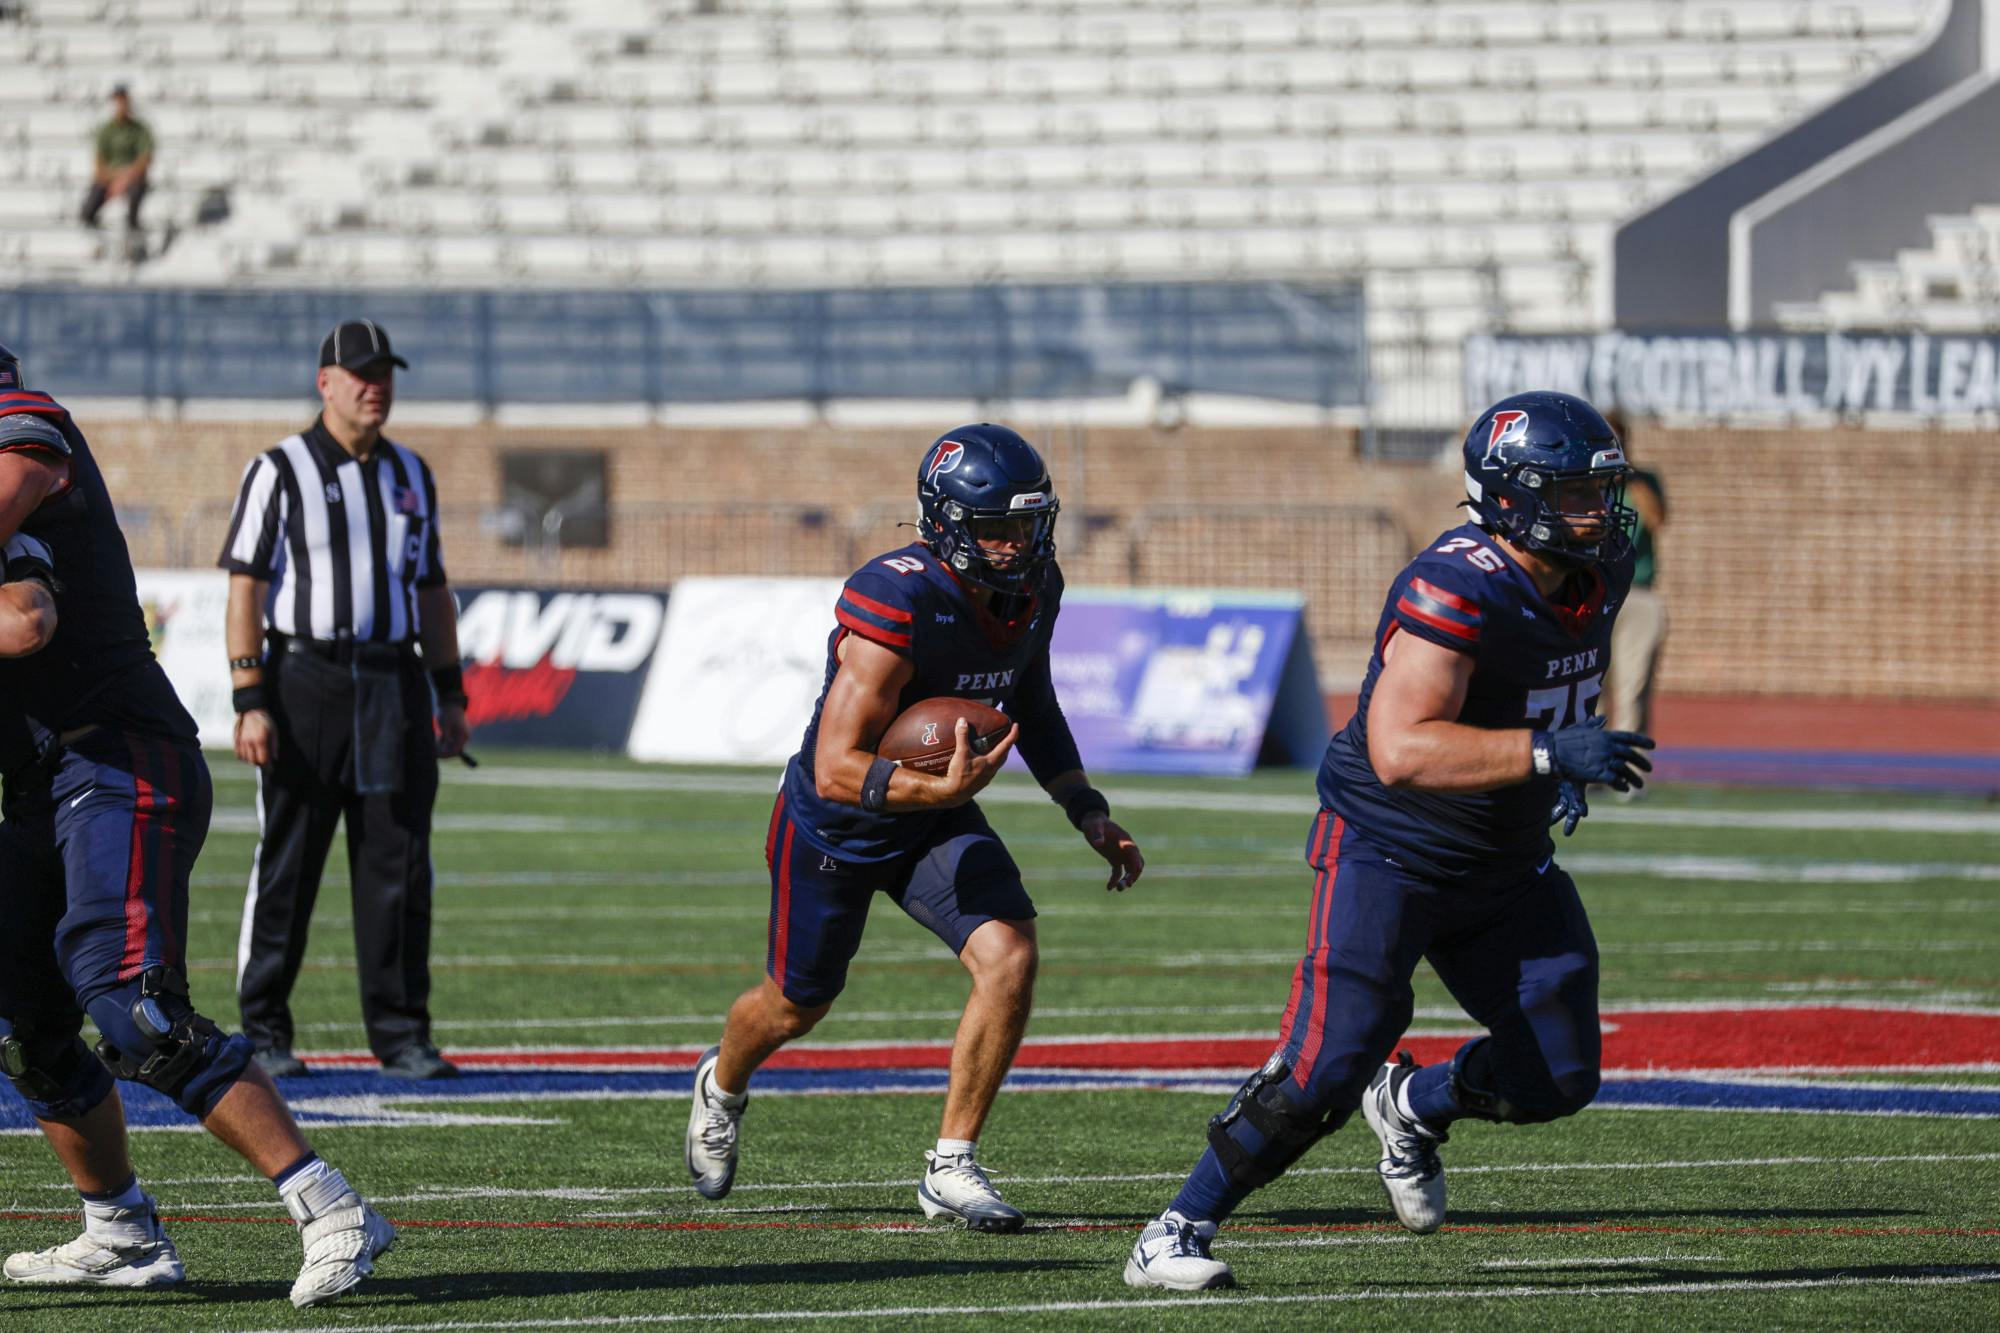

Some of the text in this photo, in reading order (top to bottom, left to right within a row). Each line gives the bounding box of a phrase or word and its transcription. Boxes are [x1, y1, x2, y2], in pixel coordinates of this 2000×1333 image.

[1592, 331, 1820, 412] FOOTBALL
[1824, 333, 1906, 411] IVY
[1911, 330, 2000, 412] LEA
[1481, 410, 1529, 470] P
[921, 440, 965, 497] P
[880, 555, 929, 577] 2
[1434, 536, 1510, 575] 75
[453, 590, 665, 673] AVID
[954, 668, 1015, 691] PENN
[1545, 648, 1599, 679] PENN
